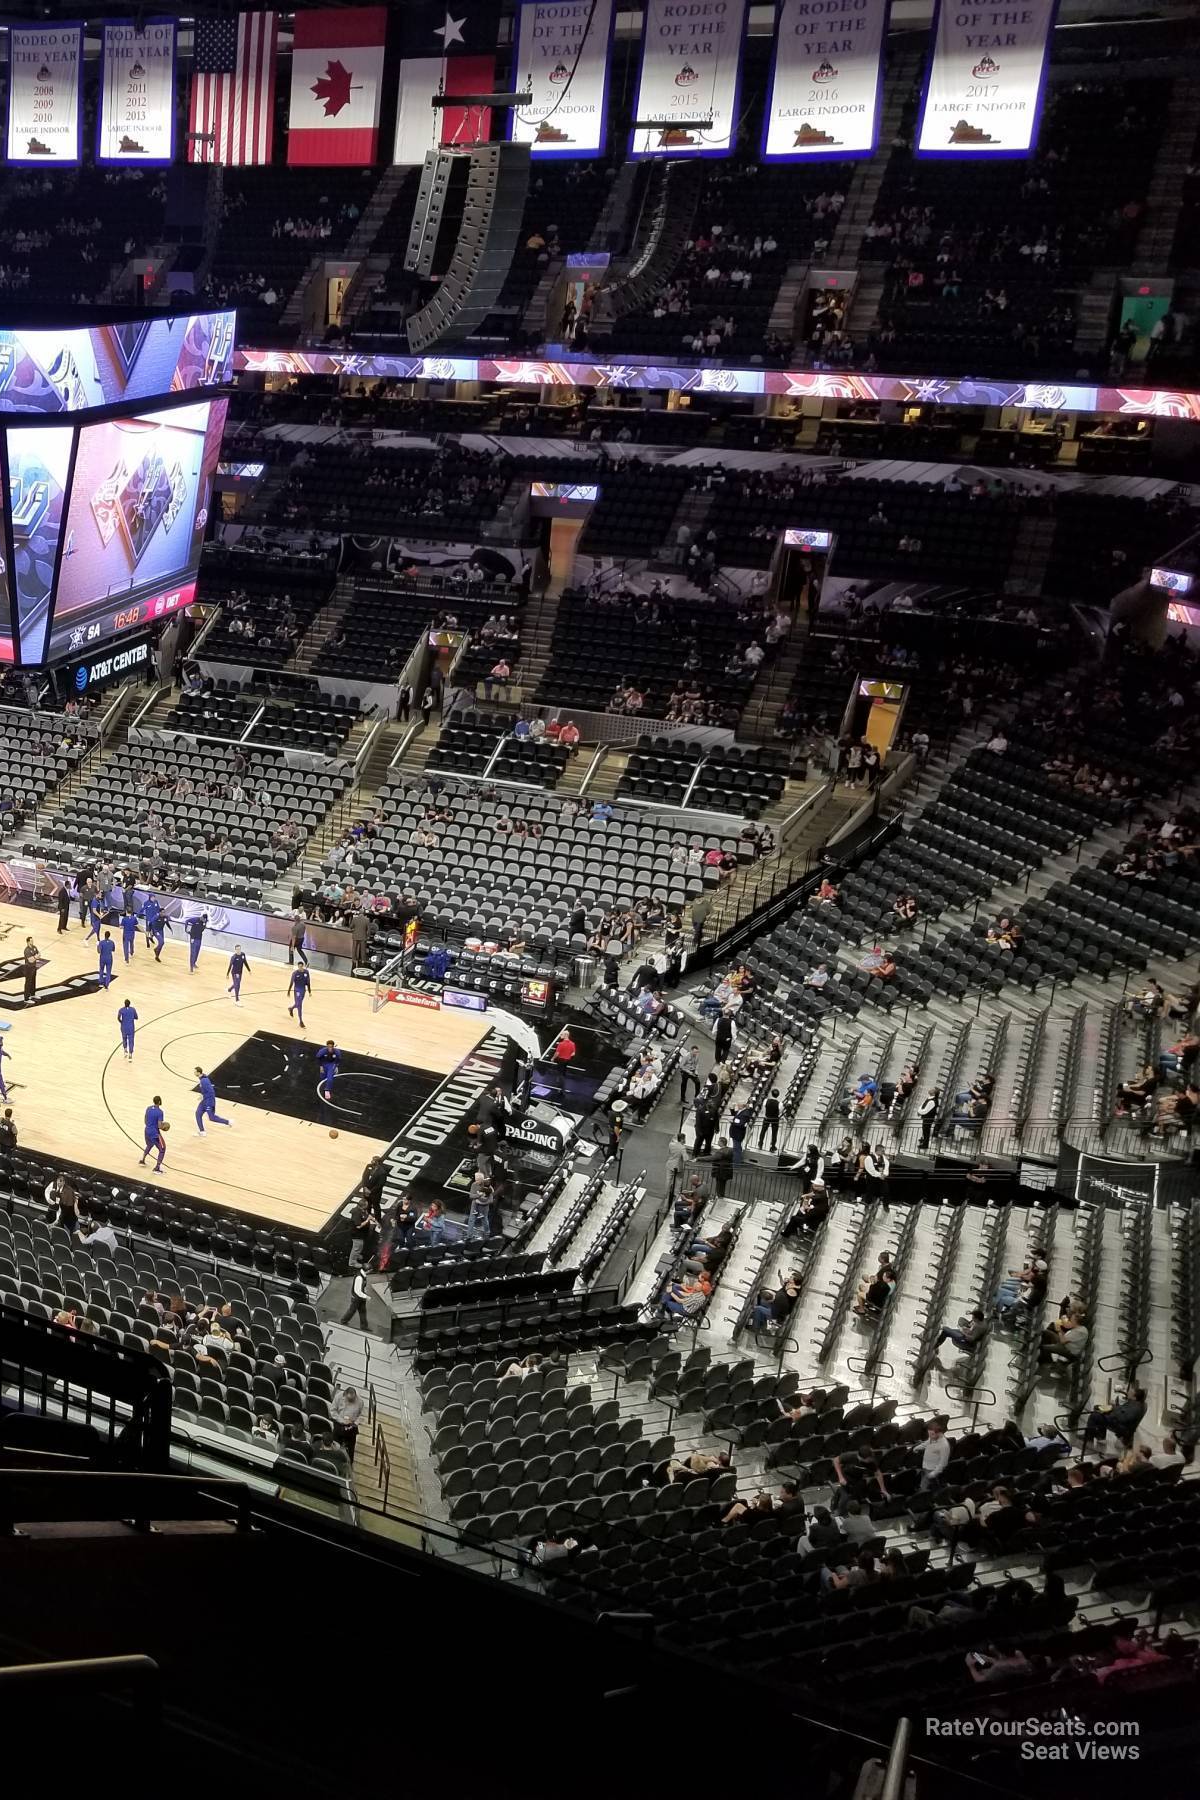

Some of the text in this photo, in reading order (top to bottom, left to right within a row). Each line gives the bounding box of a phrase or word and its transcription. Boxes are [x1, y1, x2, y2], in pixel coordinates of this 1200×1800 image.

[664, 2, 727, 17] RODEO
[800, 0, 867, 16] RODEO
[955, 10, 1033, 27] OF THE
[533, 26, 554, 38] OF
[660, 21, 726, 37] OF THE
[795, 19, 866, 36] OF THE
[13, 34, 79, 46] RODEO OF
[155, 29, 172, 40] OF
[965, 33, 1017, 47] YEAR
[107, 47, 170, 58] THE YEAR
[668, 42, 713, 55] YEAR
[803, 40, 853, 55] YEAR
[14, 51, 77, 63] THE YEAR
[34, 86, 54, 96] 2008
[127, 83, 146, 93] 2011
[965, 85, 1000, 98] 2017
[126, 97, 146, 107] 2012
[670, 93, 698, 106] 2015
[808, 89, 839, 102] 2016
[33, 100, 53, 109] 2009
[520, 104, 596, 116] LARGE INDOOR
[778, 103, 866, 117] LARGE INDOOR
[934, 102, 972, 112] LARGE
[33, 113, 53, 122] 2010
[125, 111, 146, 121] 2013
[647, 110, 720, 121] LARGE INDOOR
[87, 594, 181, 640] SA 16:48 DET
[89, 644, 148, 683] AT&T CENTER
[475, 1029, 509, 1059] AN
[405, 1058, 501, 1146] ANTONIO
[504, 1123, 557, 1150] PALDING
